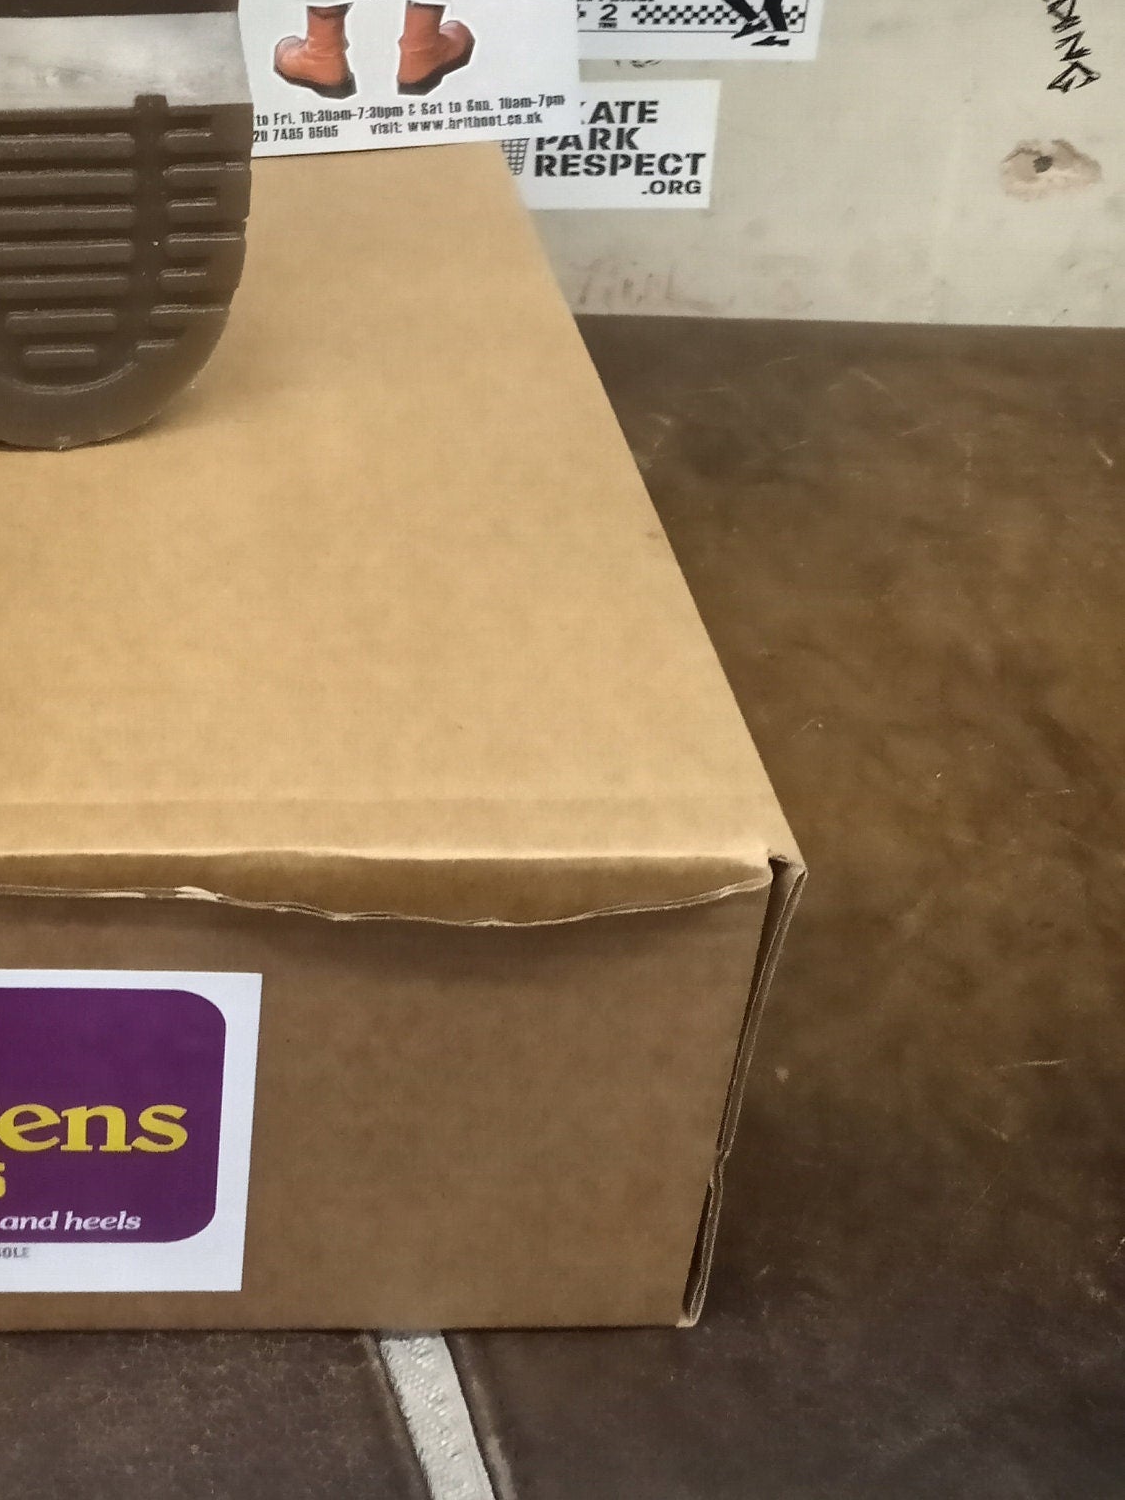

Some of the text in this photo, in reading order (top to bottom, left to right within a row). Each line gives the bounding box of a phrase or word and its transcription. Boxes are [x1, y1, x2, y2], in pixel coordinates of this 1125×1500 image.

[580, 100, 660, 124] ATE
[534, 152, 707, 177] RESPECT
[641, 179, 703, 195] .ORG
[0, 1210, 60, 1231] and
[64, 1210, 142, 1231] heels
